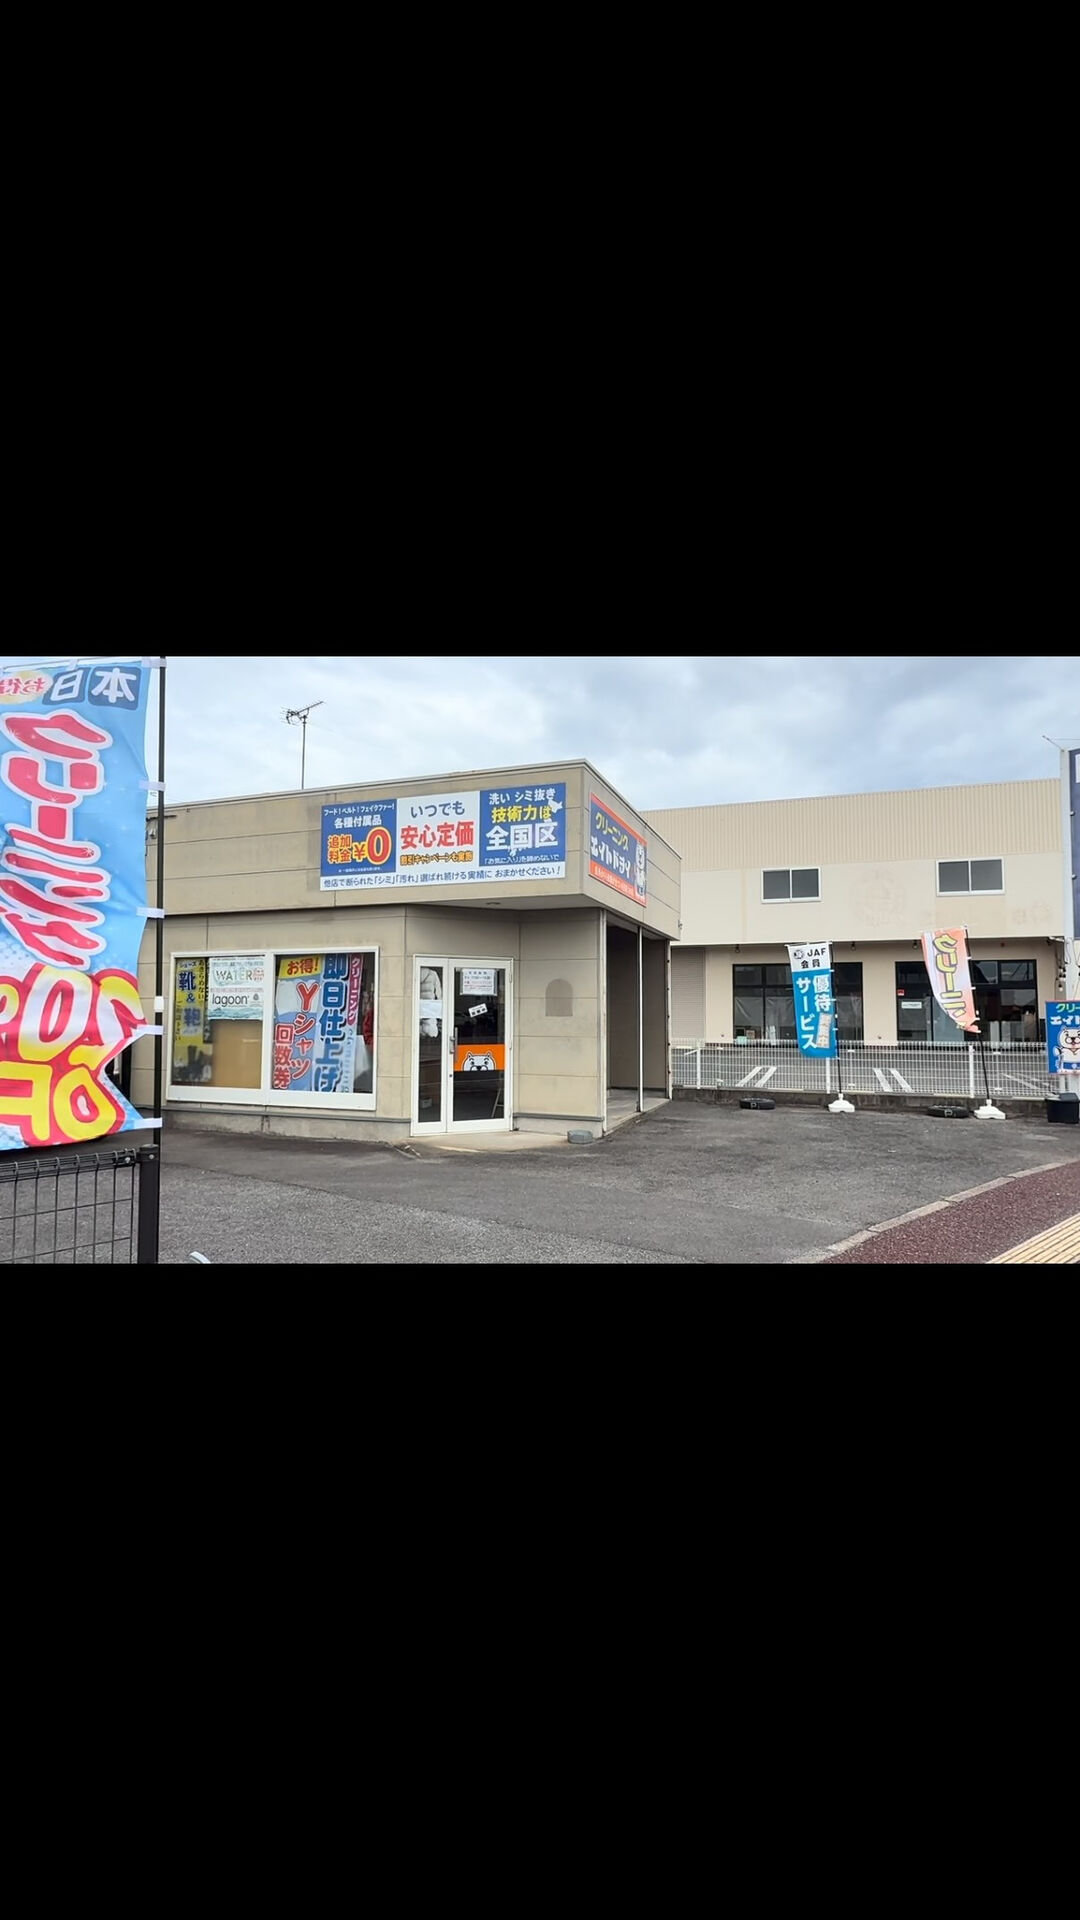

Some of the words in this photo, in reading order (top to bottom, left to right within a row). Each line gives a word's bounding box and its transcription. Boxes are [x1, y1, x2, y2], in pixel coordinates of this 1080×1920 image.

[489, 793, 510, 805] 洗い
[515, 788, 556, 802] シミ抜き
[410, 801, 465, 818] いつでも
[492, 805, 552, 823] 技術力は
[334, 815, 382, 829] 各種付属品
[328, 834, 352, 849] 追加
[401, 822, 475, 850] 安心定価
[486, 822, 558, 851] 全国区
[328, 848, 352, 864] 料金
[591, 836, 631, 879] エイトドライ
[807, 948, 826, 957] JAF
[801, 959, 820, 969] 会員
[178, 971, 196, 991] 靴
[198, 960, 206, 1004] あきらめない
[215, 970, 253, 980] WATER
[348, 957, 361, 1022] クリーニング
[813, 974, 831, 1012] 優待
[212, 993, 248, 1007] lagoon
[312, 954, 348, 1092] 即日仕上げ
[796, 977, 817, 1050] サービス
[273, 1023, 295, 1090] 回数券
